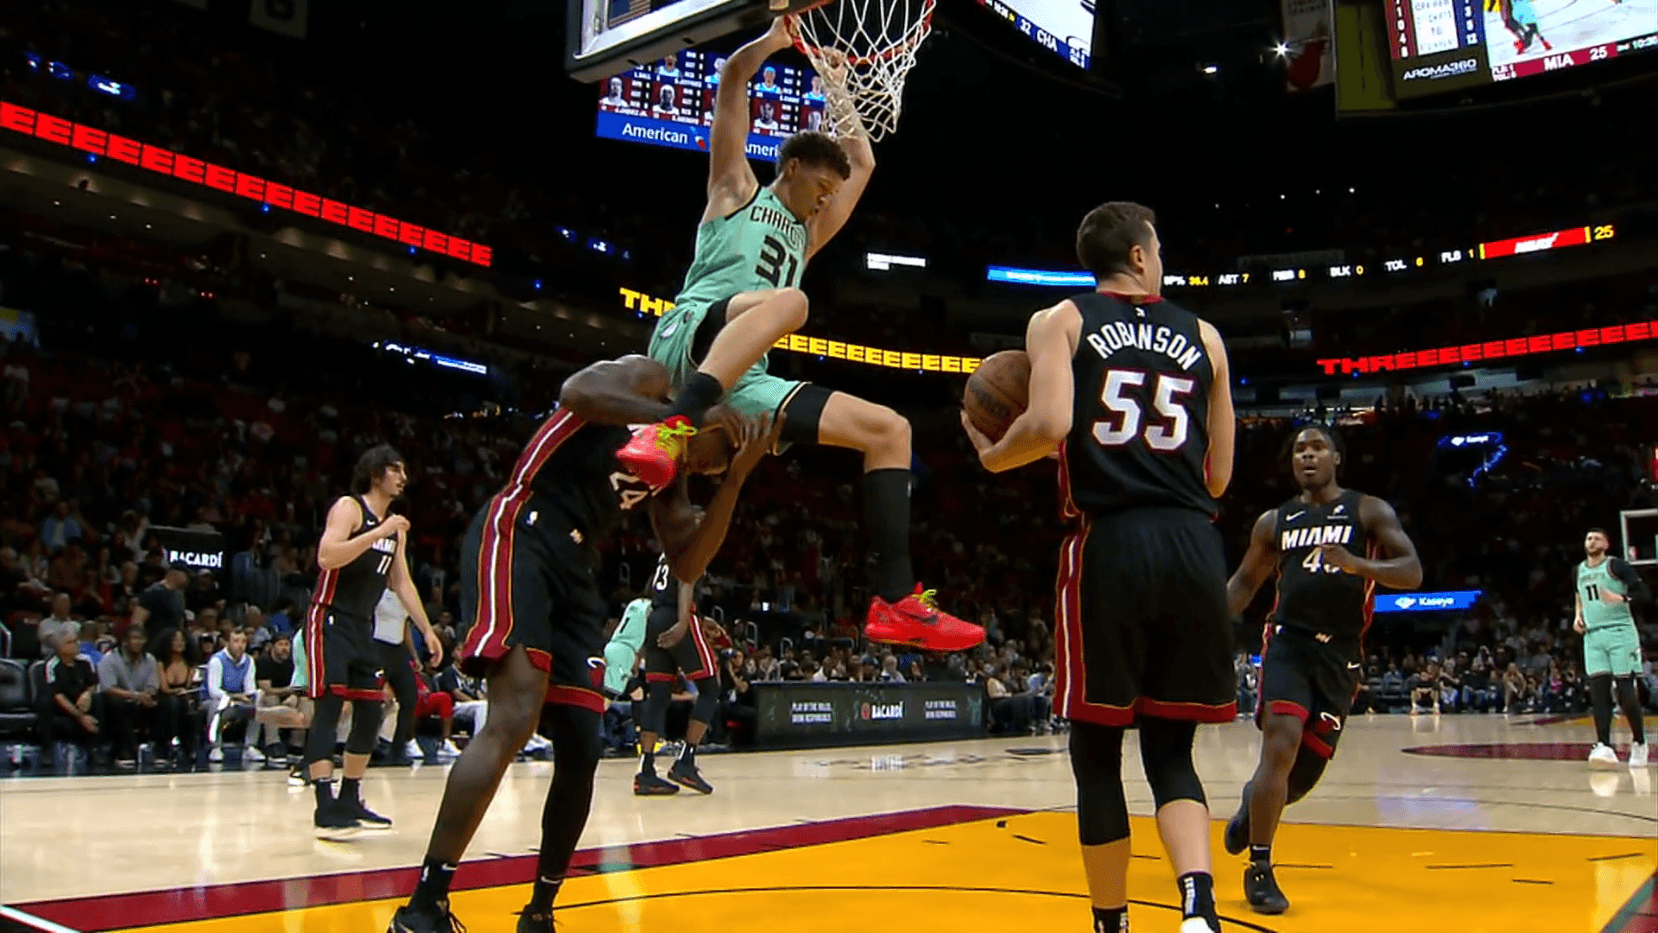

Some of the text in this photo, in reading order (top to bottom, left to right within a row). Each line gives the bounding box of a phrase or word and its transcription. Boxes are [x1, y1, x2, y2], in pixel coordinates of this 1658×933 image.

[1037, 29, 1058, 52] CHA
[1544, 53, 1574, 71] MIA
[1589, 46, 1608, 60] 25
[622, 122, 688, 145] American
[1594, 225, 1615, 241] 25
[755, 234, 797, 288] 31
[1218, 273, 1240, 285] AST
[1242, 273, 1250, 284] 7
[1330, 265, 1351, 277] BLK
[1385, 259, 1407, 271] TOL
[1086, 321, 1202, 371] ROBINSON
[1091, 368, 1195, 451] 55
[1281, 525, 1353, 551] MIAMI
[376, 554, 393, 575] 11
[1302, 547, 1342, 573] 4
[651, 563, 670, 591] 13
[1585, 583, 1600, 601] 11
